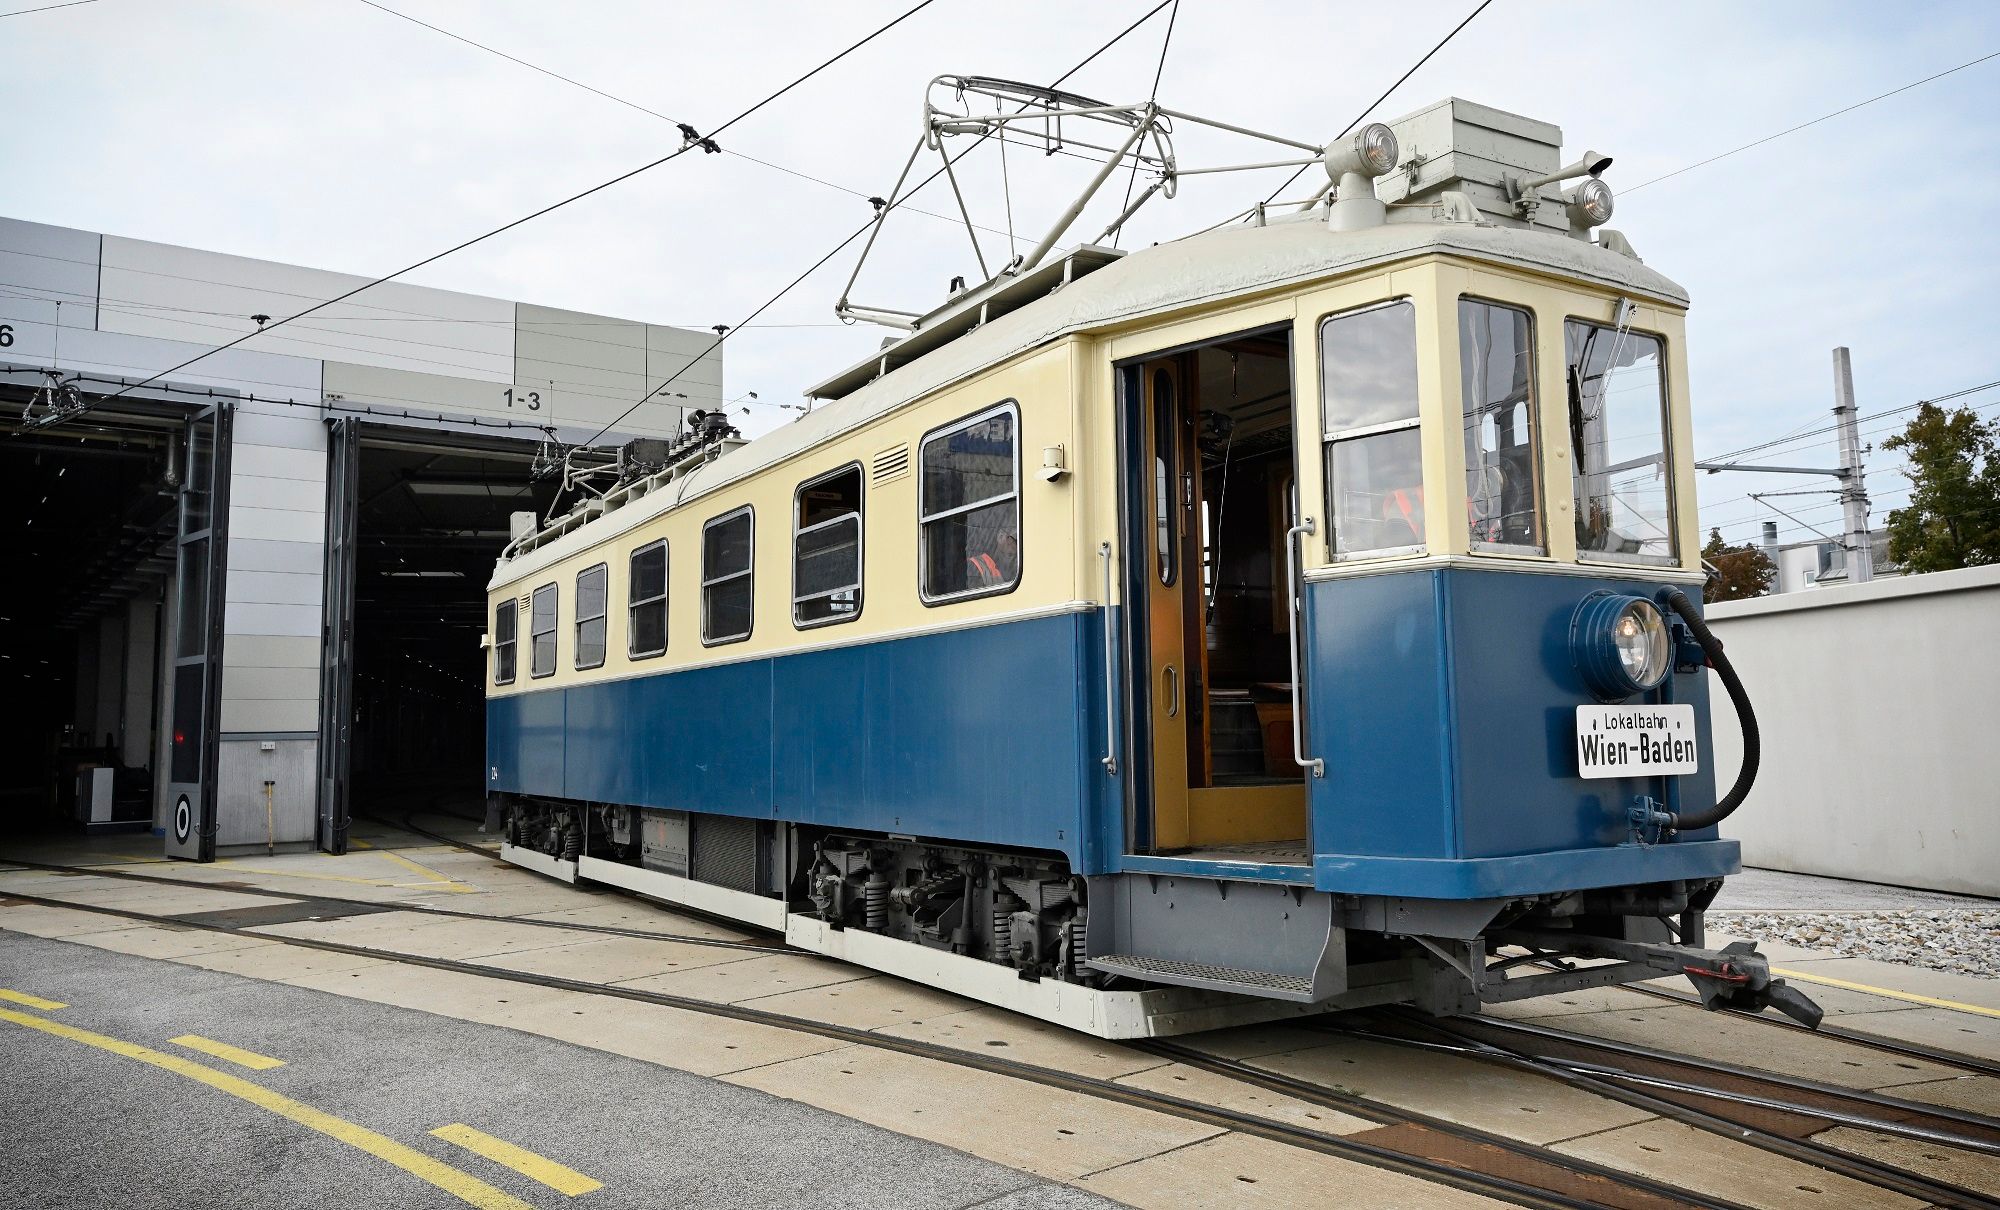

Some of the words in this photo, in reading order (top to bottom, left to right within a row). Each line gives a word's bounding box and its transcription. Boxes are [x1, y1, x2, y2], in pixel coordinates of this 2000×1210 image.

[503, 388, 541, 411] 1-3
[1604, 712, 1668, 730] Lokalbahn
[1580, 732, 1695, 767] Wien-Baden
